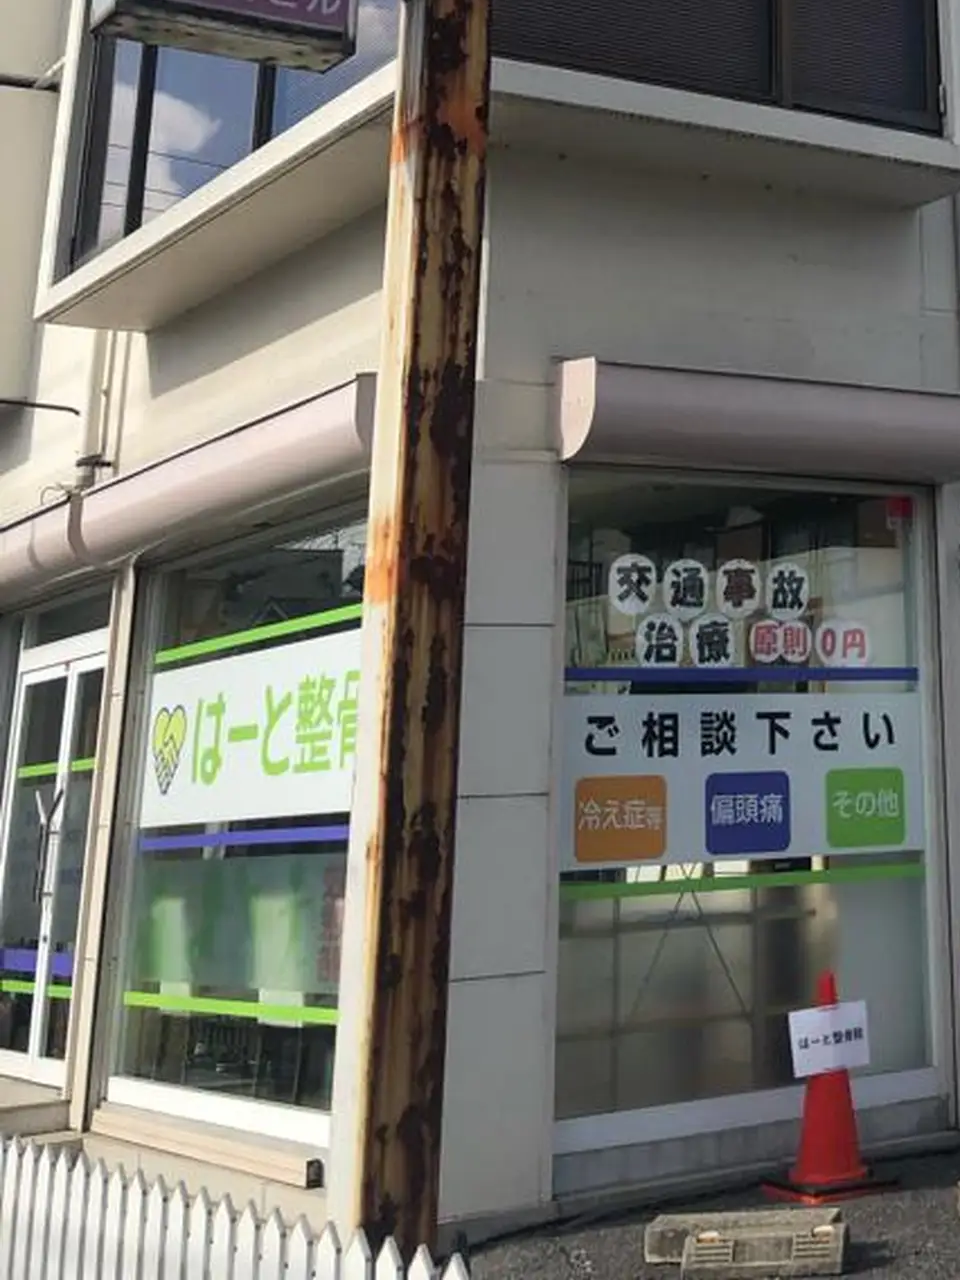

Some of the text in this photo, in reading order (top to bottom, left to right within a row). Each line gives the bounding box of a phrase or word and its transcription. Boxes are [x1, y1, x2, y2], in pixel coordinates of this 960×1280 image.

[616, 562, 805, 609] 交通事故
[584, 711, 896, 758] ご相談下さい
[710, 793, 785, 827] 偏頭痛
[832, 788, 900, 819] その他
